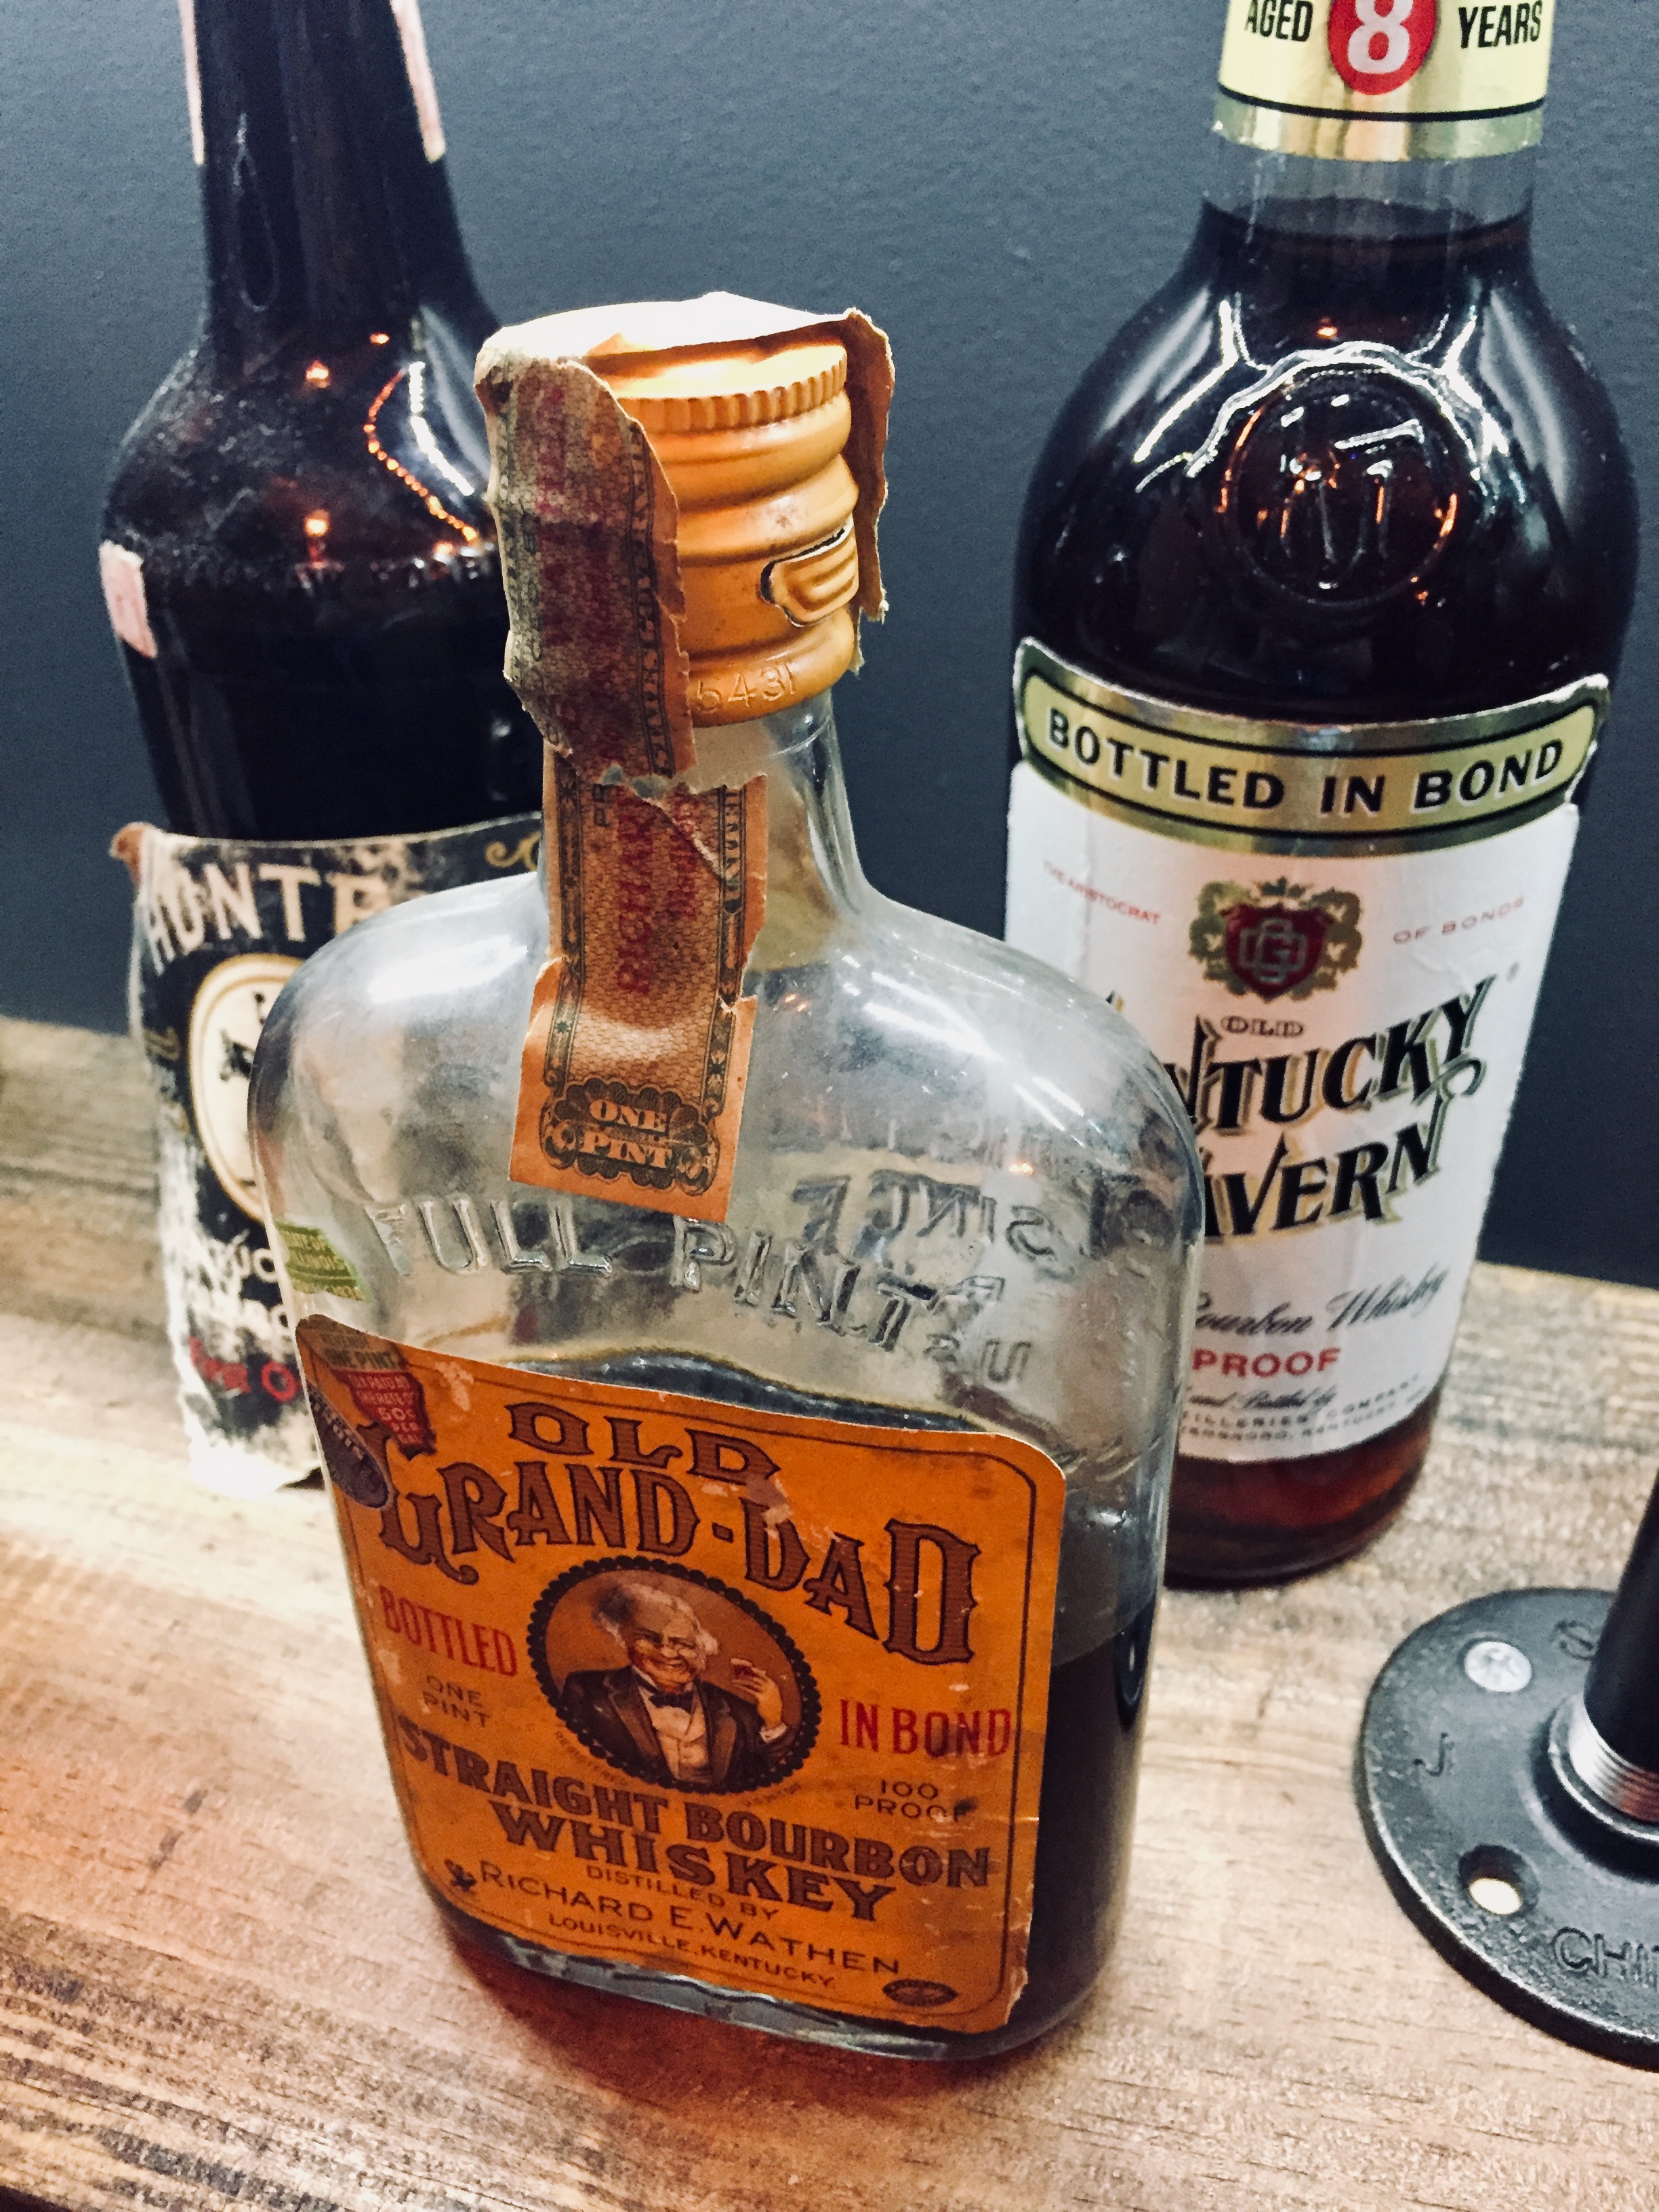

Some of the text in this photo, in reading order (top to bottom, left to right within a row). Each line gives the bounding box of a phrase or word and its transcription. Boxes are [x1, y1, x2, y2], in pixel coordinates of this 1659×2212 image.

[1245, 0, 1543, 75] AGED 8 YEARS
[1047, 707, 1563, 813] BOTTLED IN BOND
[1393, 925, 1430, 944] OF
[1164, 973, 1495, 1132] NTUCKY
[1221, 1016, 1305, 1038] OLD
[589, 1098, 667, 1134] ONE
[578, 1130, 674, 1170] PINT
[673, 1216, 937, 1352] PINT
[1192, 1347, 1341, 1378] PROOF
[504, 1401, 781, 1486] OLD
[377, 1422, 982, 1666] GRAND-DAD
[379, 1584, 518, 1677] BOTTLED
[422, 1692, 493, 1729] PINT
[426, 1674, 482, 1706] ONE
[840, 1698, 1012, 1757] IN BOND
[398, 1715, 669, 1835] STRAIGHT
[684, 1800, 991, 1888] BOURBON
[881, 1780, 939, 1801] 100
[488, 1799, 897, 1922] WHISKEY
[479, 1860, 654, 1923] RICHARD
[586, 1864, 779, 1921] DISTILLED BY
[701, 1944, 836, 1986] KENTUCKY
[1549, 1926, 1659, 1989] CHI
